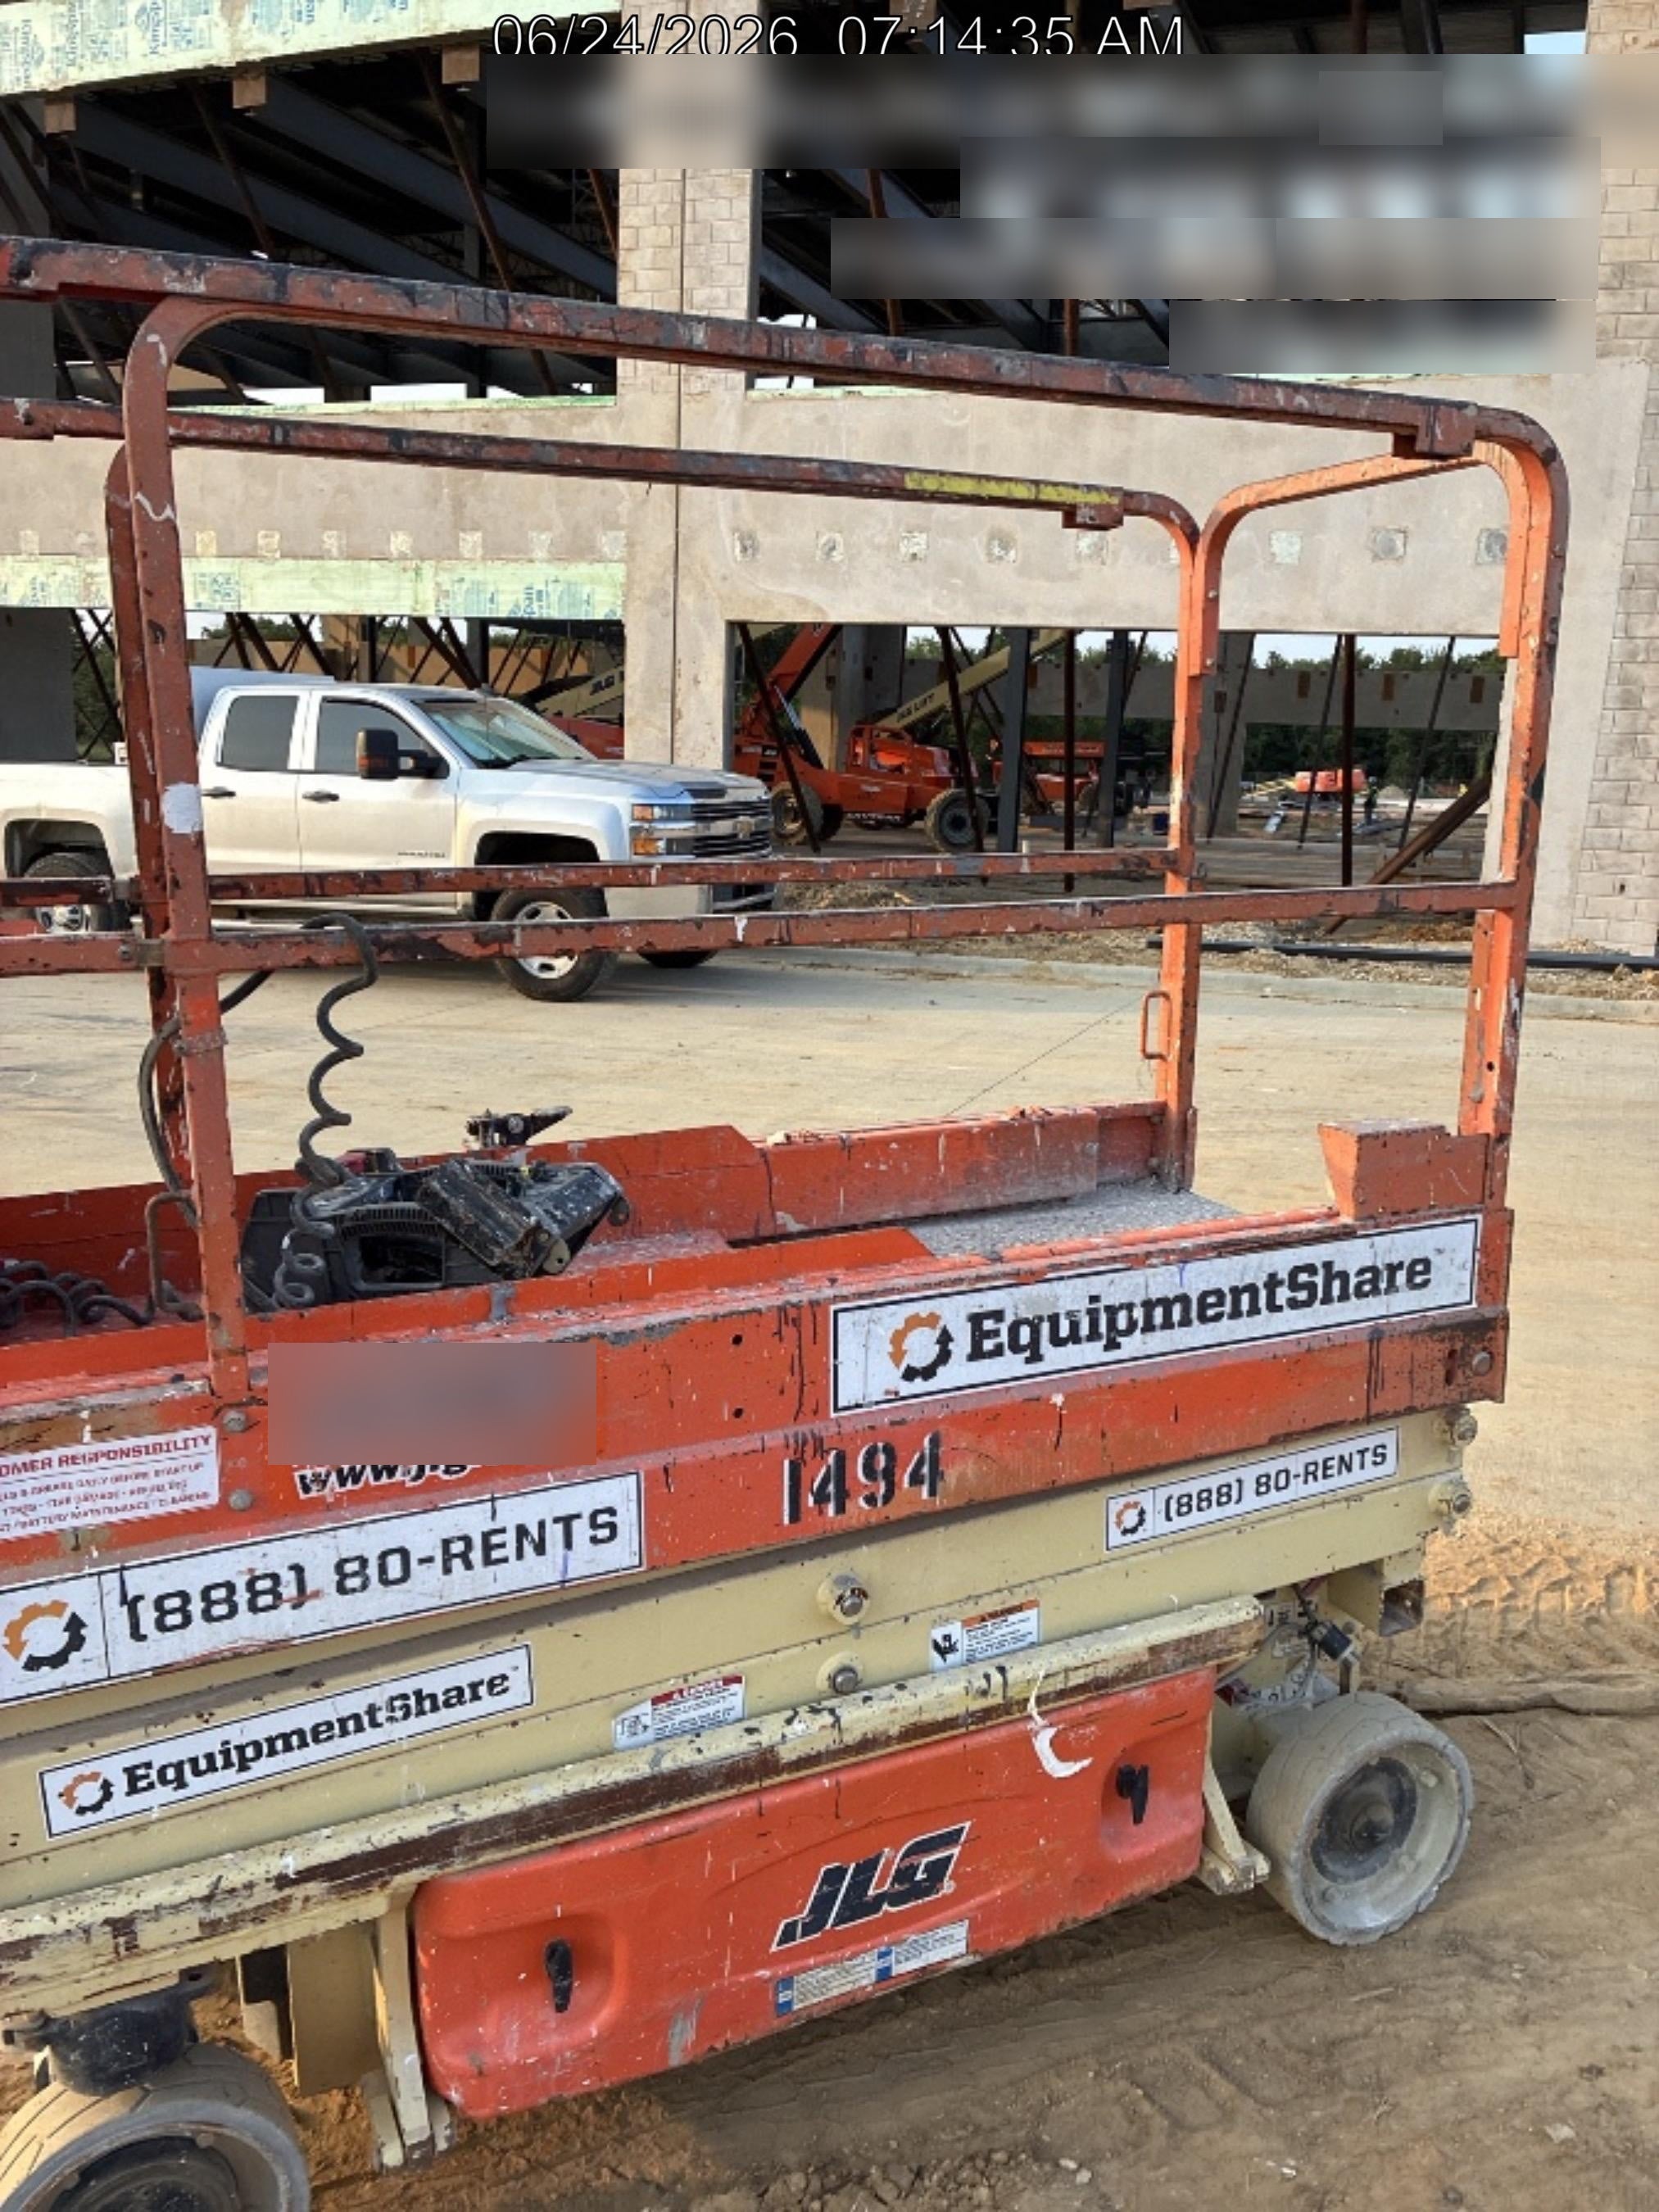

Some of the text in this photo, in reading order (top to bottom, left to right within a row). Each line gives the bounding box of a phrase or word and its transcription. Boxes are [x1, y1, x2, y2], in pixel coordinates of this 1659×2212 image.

[966, 1256, 1432, 1364] EquipmentShare
[58, 1435, 211, 1467] RESPONSIBILITY
[1164, 1444, 1388, 1522] (888) 80-RENTS
[125, 1506, 619, 1643] (888) 80-RENTS
[123, 1672, 510, 1797] EquipmentShare
[770, 1820, 971, 1951] JLG
